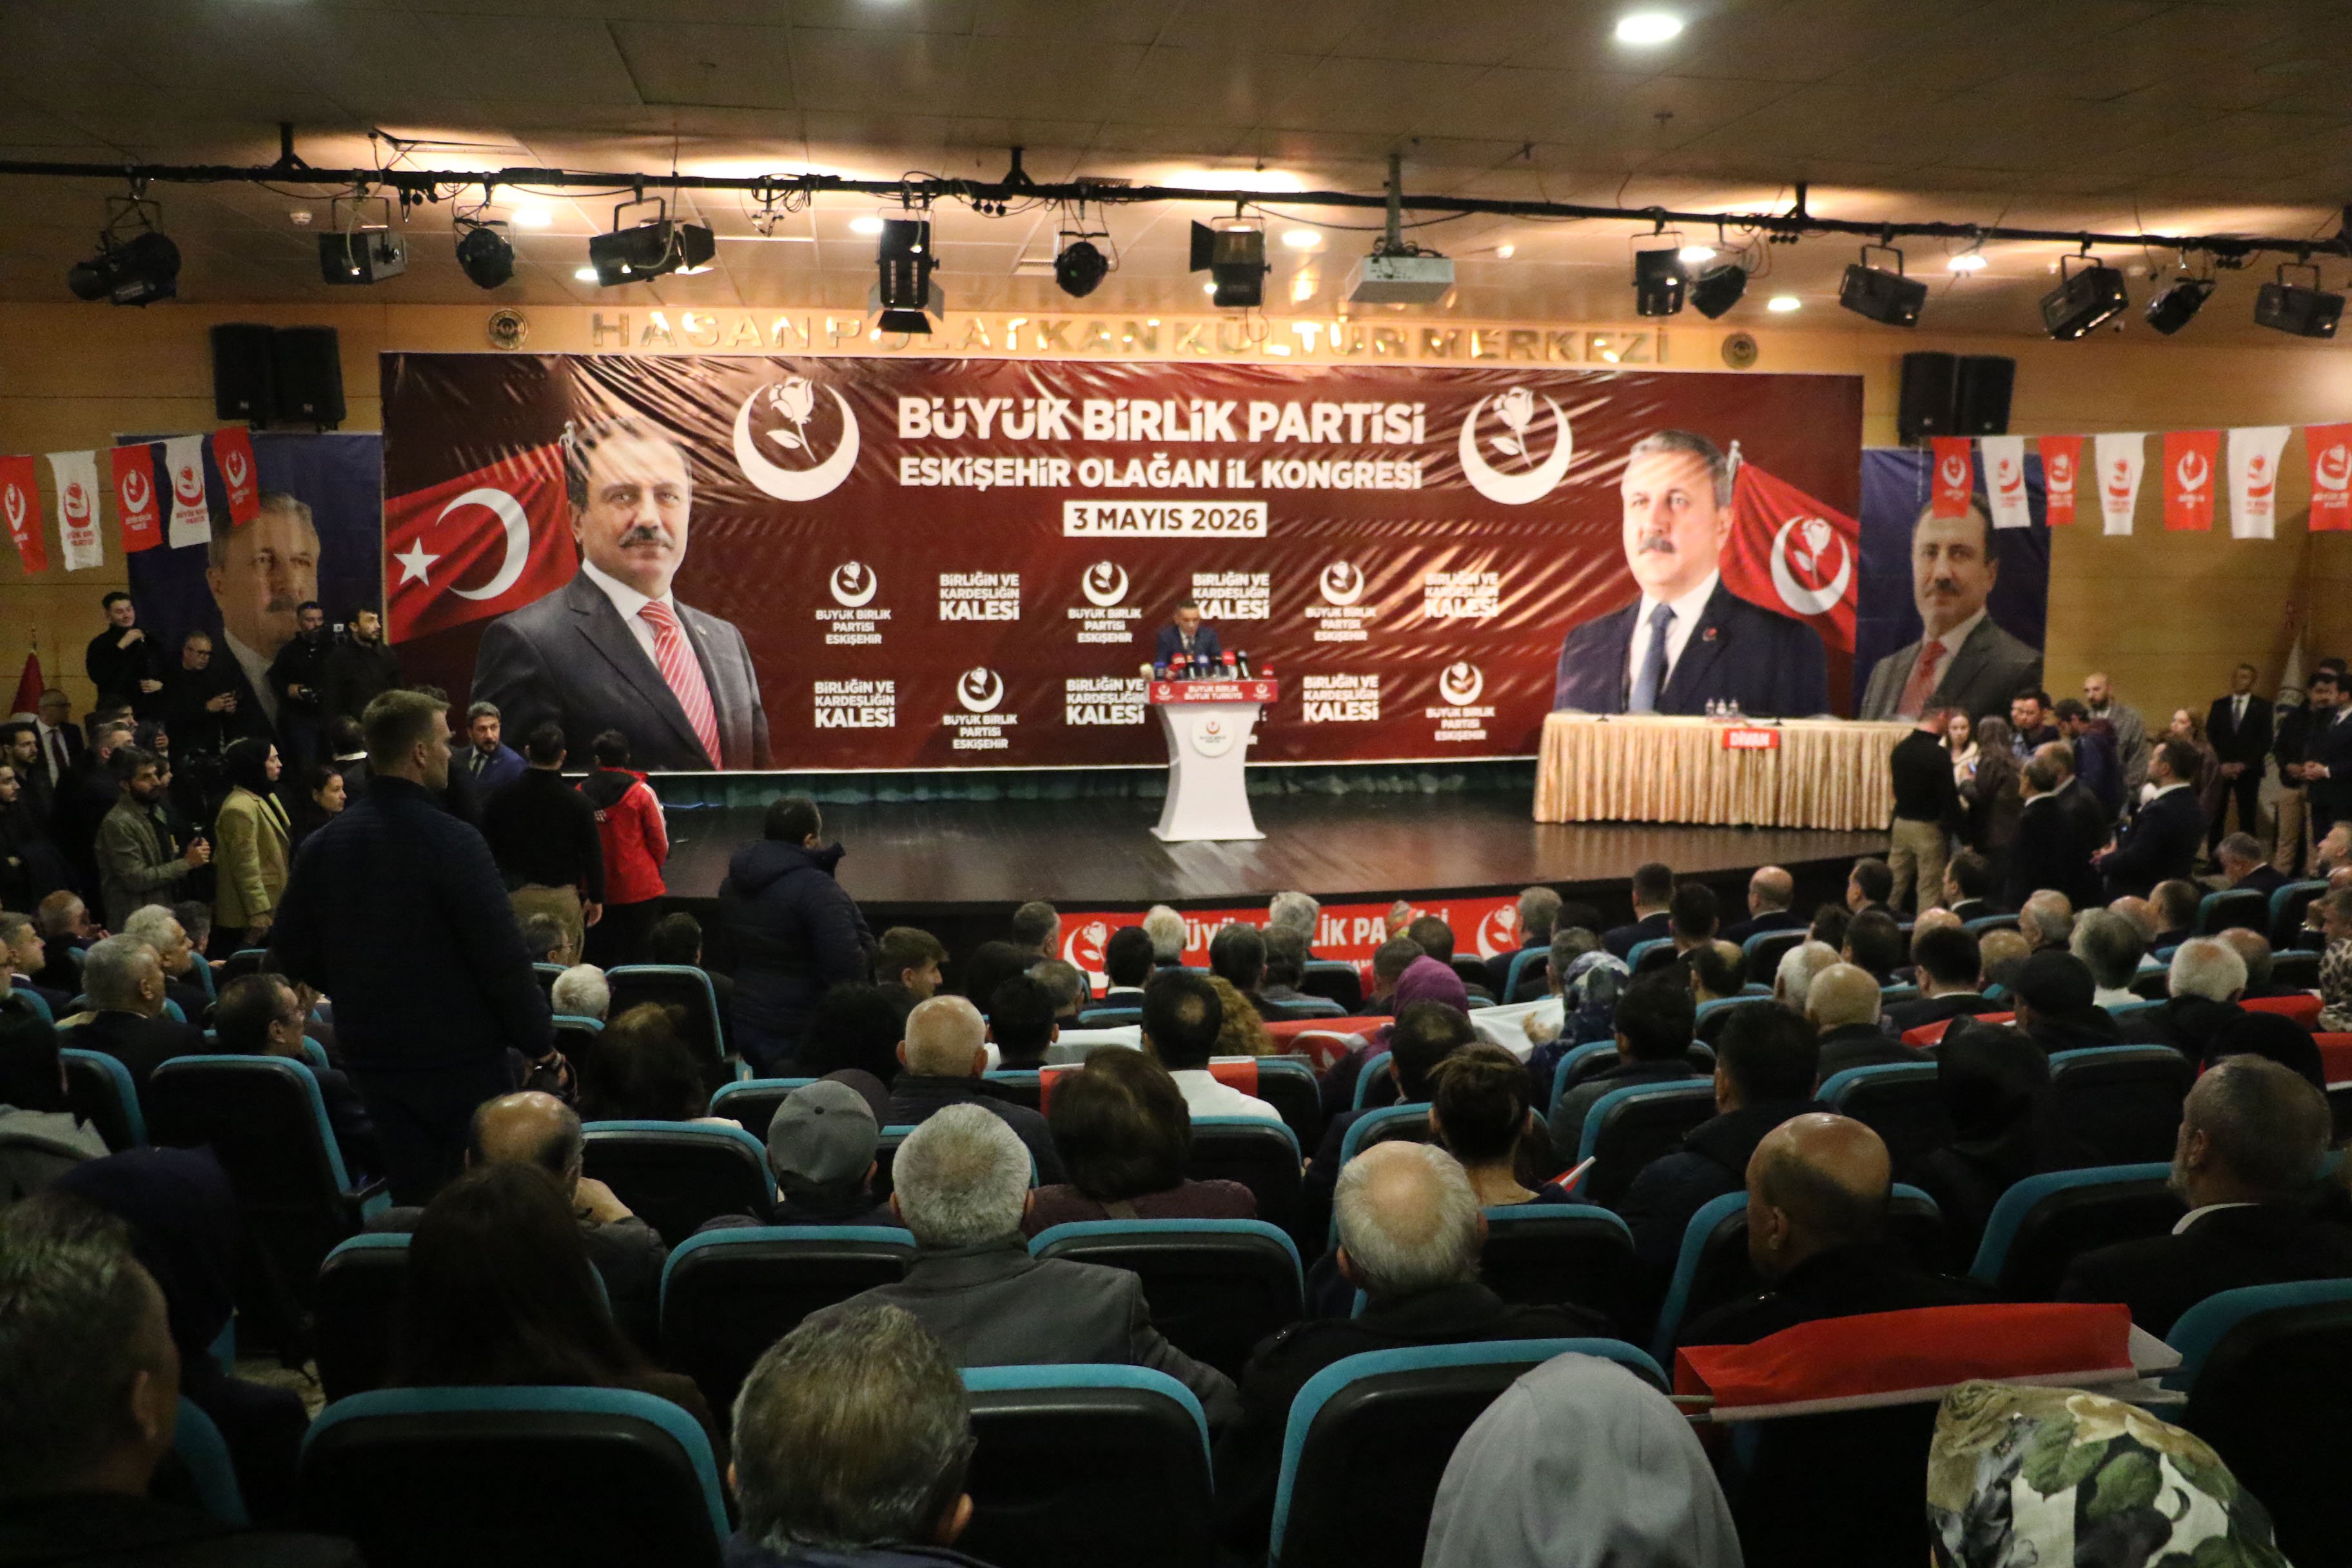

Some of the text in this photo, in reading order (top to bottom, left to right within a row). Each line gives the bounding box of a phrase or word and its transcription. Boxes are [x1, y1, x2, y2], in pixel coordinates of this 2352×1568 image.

[593, 311, 810, 348] HASAN
[899, 397, 1425, 444] BÜYÜK BİRLİK PARTİSİ
[900, 453, 1424, 492] ESKİŞEHİR OLAĞAN İL KONGRESİ
[1073, 508, 1259, 531] 3 MAYIS 2026
[940, 571, 1019, 587] BİRLİĞİN VE
[1192, 571, 1269, 586] BİRLİĞİN VE
[940, 586, 1019, 600] KARDEŞLİĞİN
[816, 609, 891, 620] BÜYÜK BİRLİK
[940, 600, 1020, 620] KALESİ
[1068, 609, 1141, 619] BÜYÜK BİRLİK
[1424, 597, 1499, 618] KALESİ
[832, 622, 875, 632] PARTİSİ
[1084, 620, 1126, 631] PARTİSİ
[826, 634, 882, 645] ESKİŞEHİR
[1077, 632, 1132, 643] ESKİŞEHİR
[814, 678, 895, 694] BİRLİĞİN VE
[1066, 676, 1145, 692] BİRLİĞİN VE
[1303, 673, 1379, 689] BİRLİĞİN VE
[815, 693, 895, 707] KARDEŞLİĞİN
[815, 707, 896, 728] KALESİ
[1066, 704, 1145, 725] KALESİ
[1303, 701, 1379, 721] KALESİ
[943, 714, 1017, 725] BÜYÜK BİRLİK
[959, 727, 1001, 737] PARTİSİ
[953, 738, 1008, 750] ESKİŞEHİR
